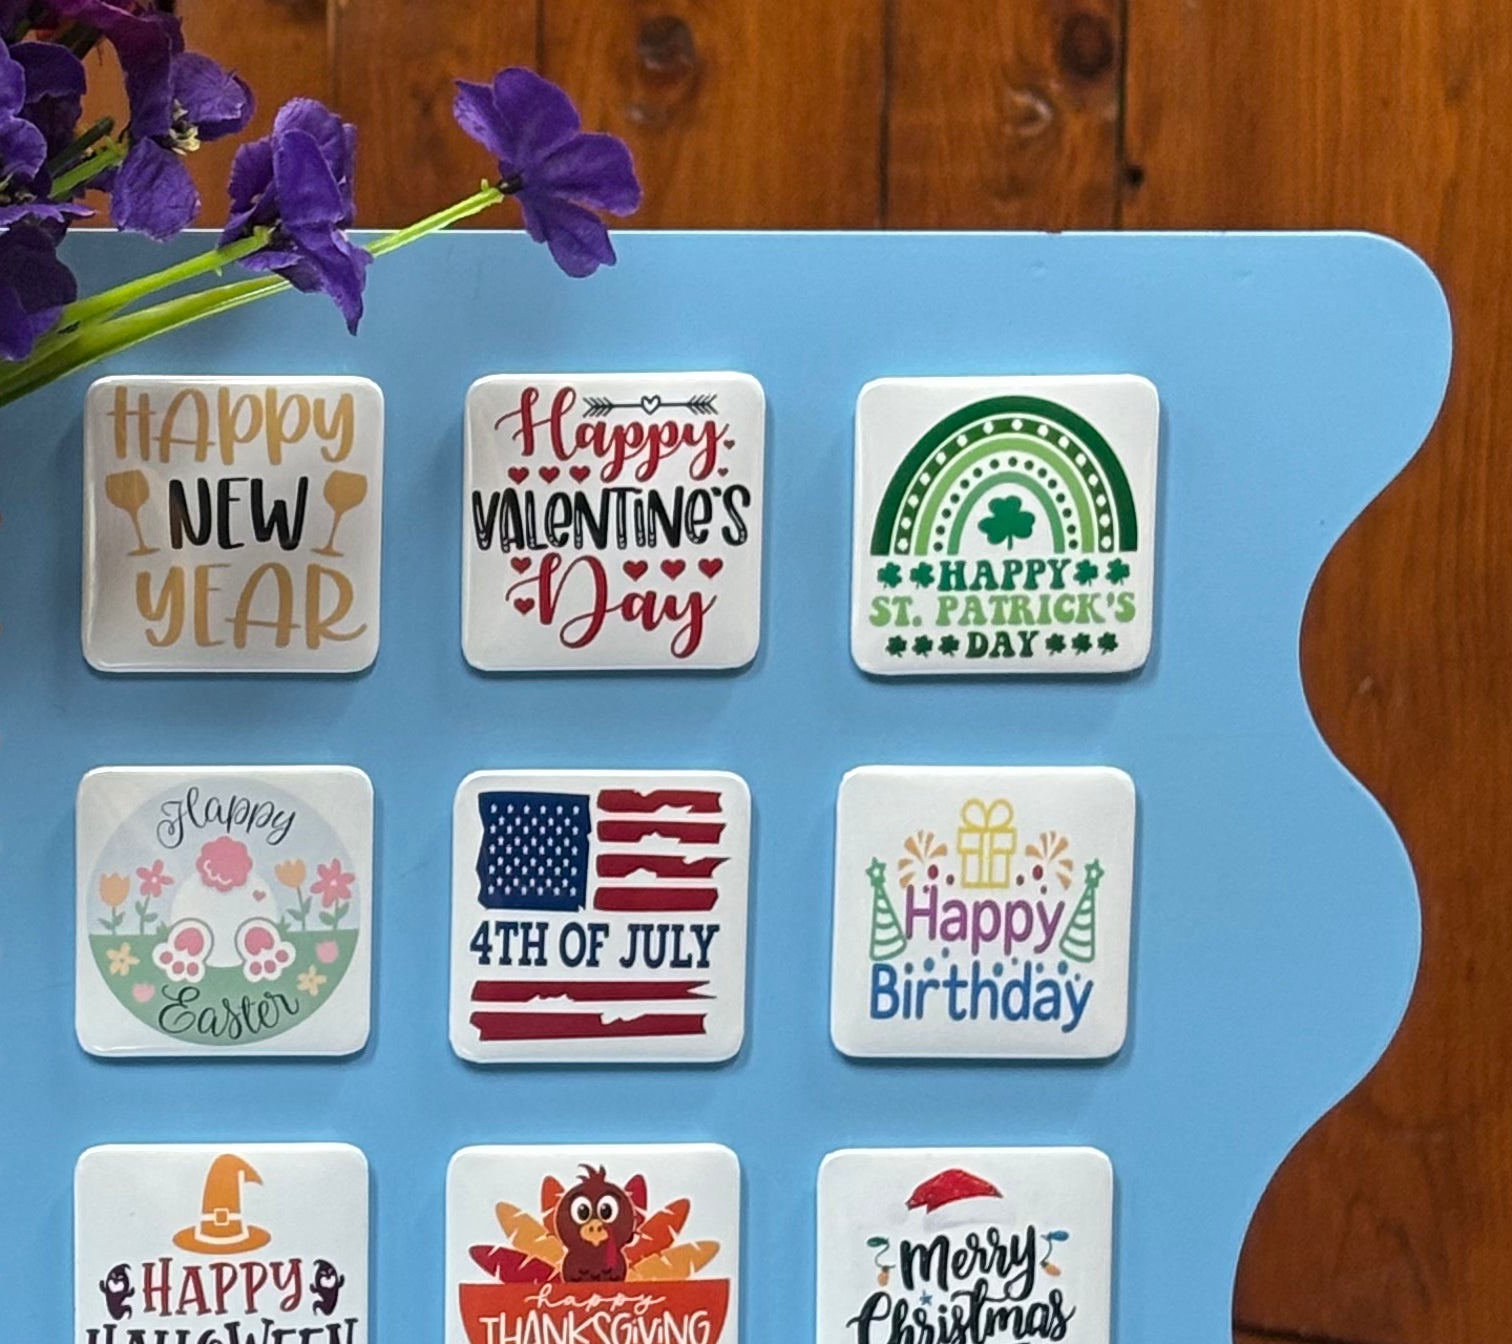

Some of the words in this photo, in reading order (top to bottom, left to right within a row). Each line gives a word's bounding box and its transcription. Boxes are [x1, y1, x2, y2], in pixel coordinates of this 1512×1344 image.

[494, 386, 729, 482] Happy
[169, 476, 308, 551] NEW
[136, 562, 368, 649] YEAR
[505, 552, 717, 658] Day
[937, 558, 1071, 591] HAPPY
[869, 594, 922, 627] ST.
[935, 591, 1136, 626] PATRICK'S
[965, 630, 1040, 658] DAY
[156, 786, 296, 849] Happy
[470, 921, 549, 966] 4TH
[559, 921, 609, 967] OF
[619, 923, 720, 968] JULY
[905, 884, 1065, 956] Happy
[157, 985, 300, 1040] Easter
[870, 960, 1094, 1033] Birthday
[141, 1257, 302, 1316] HAPPY
[900, 1224, 1036, 1302] Merry
[524, 1283, 666, 1313] happy
